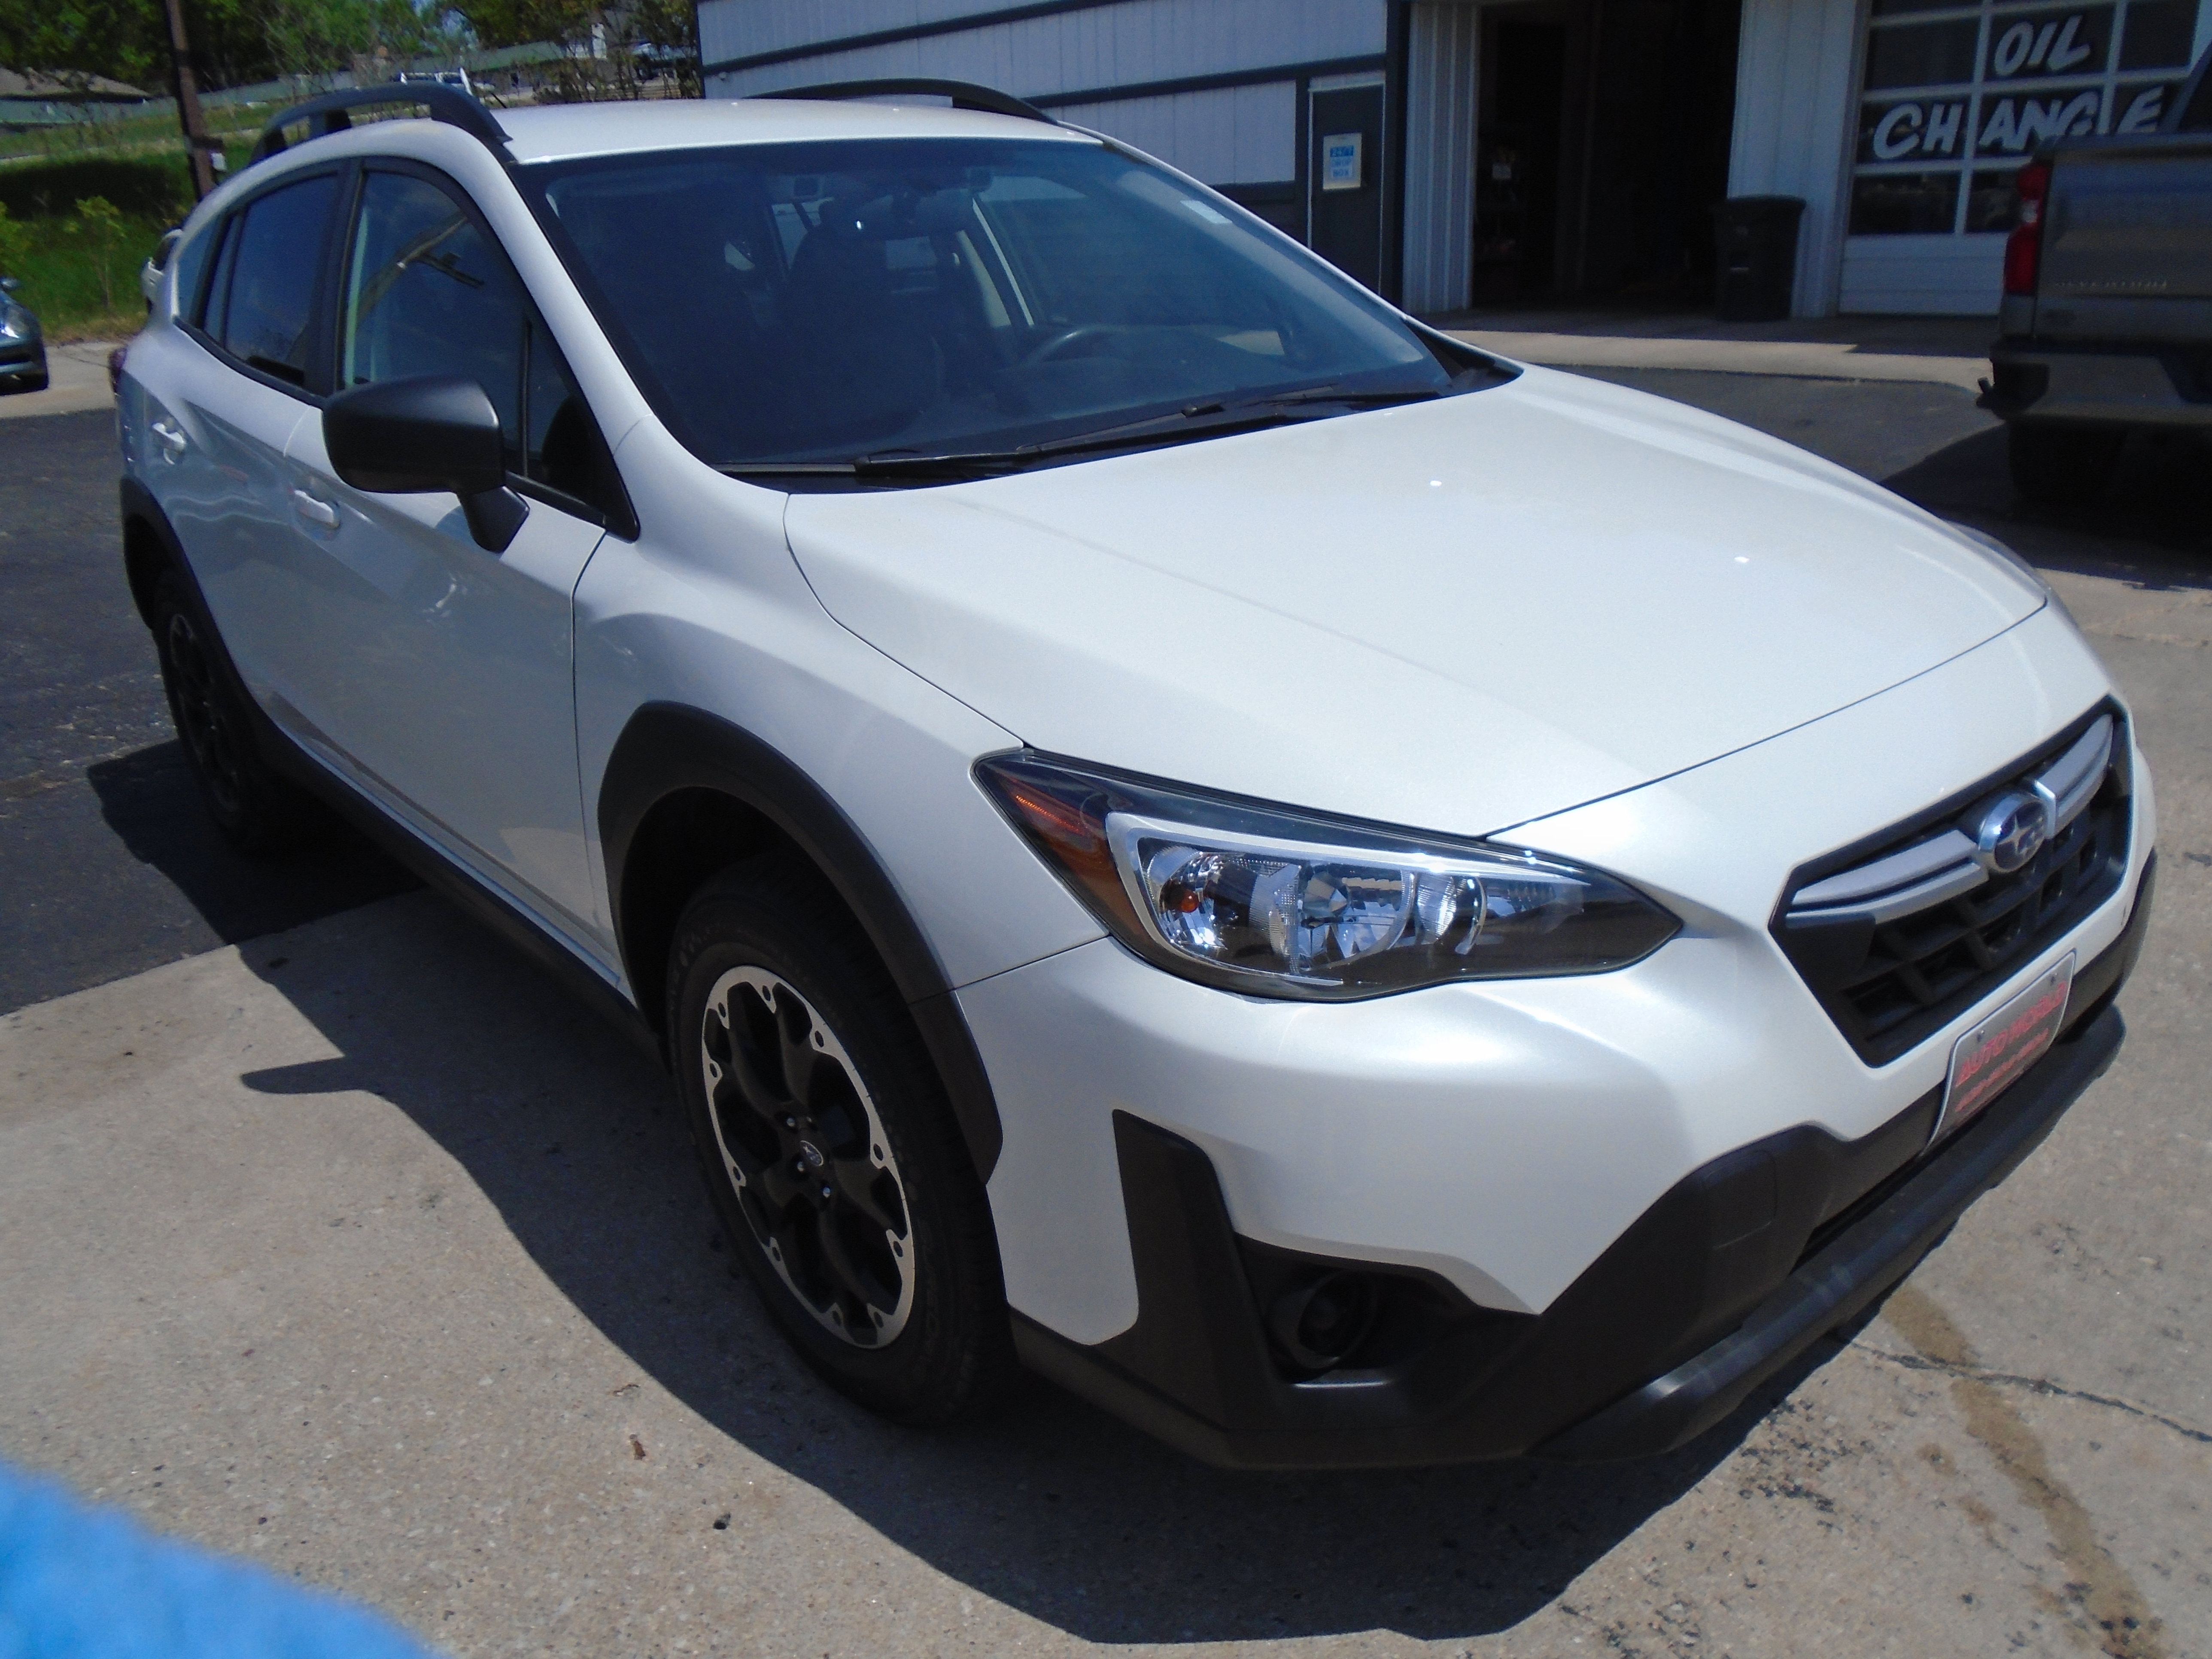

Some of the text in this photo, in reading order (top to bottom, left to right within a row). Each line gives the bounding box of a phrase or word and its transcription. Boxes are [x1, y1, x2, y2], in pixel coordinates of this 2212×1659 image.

[1994, 15, 2090, 76] OIL
[1873, 87, 2163, 158] CHANGE
[1955, 1029, 2008, 1088] AUTO
